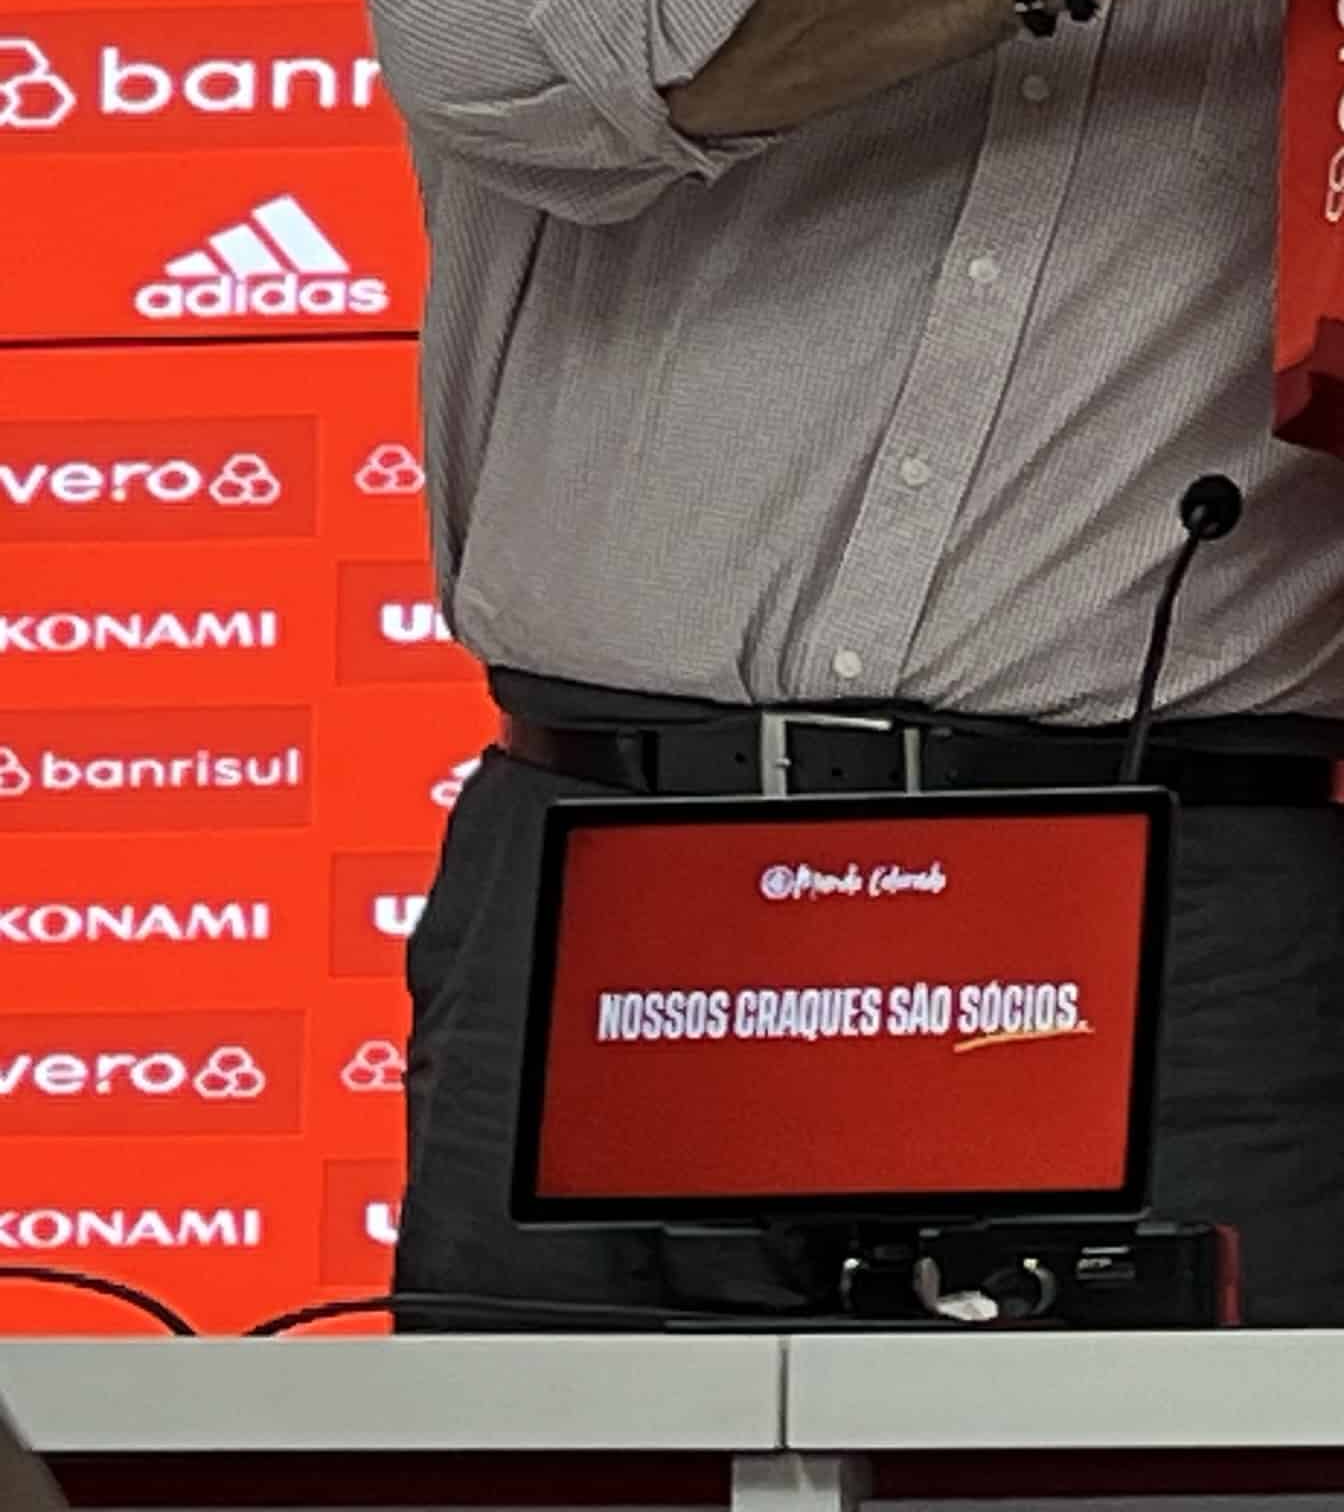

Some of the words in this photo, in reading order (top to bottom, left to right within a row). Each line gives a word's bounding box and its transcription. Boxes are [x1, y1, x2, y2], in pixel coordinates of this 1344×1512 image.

[101, 46, 381, 114] banr
[135, 273, 390, 319] adidas
[0, 460, 201, 505] vero
[42, 748, 300, 789] banrisul
[597, 990, 731, 1042] NOSSOS
[732, 987, 882, 1041] CRAQUES
[886, 981, 952, 1035] SÃO
